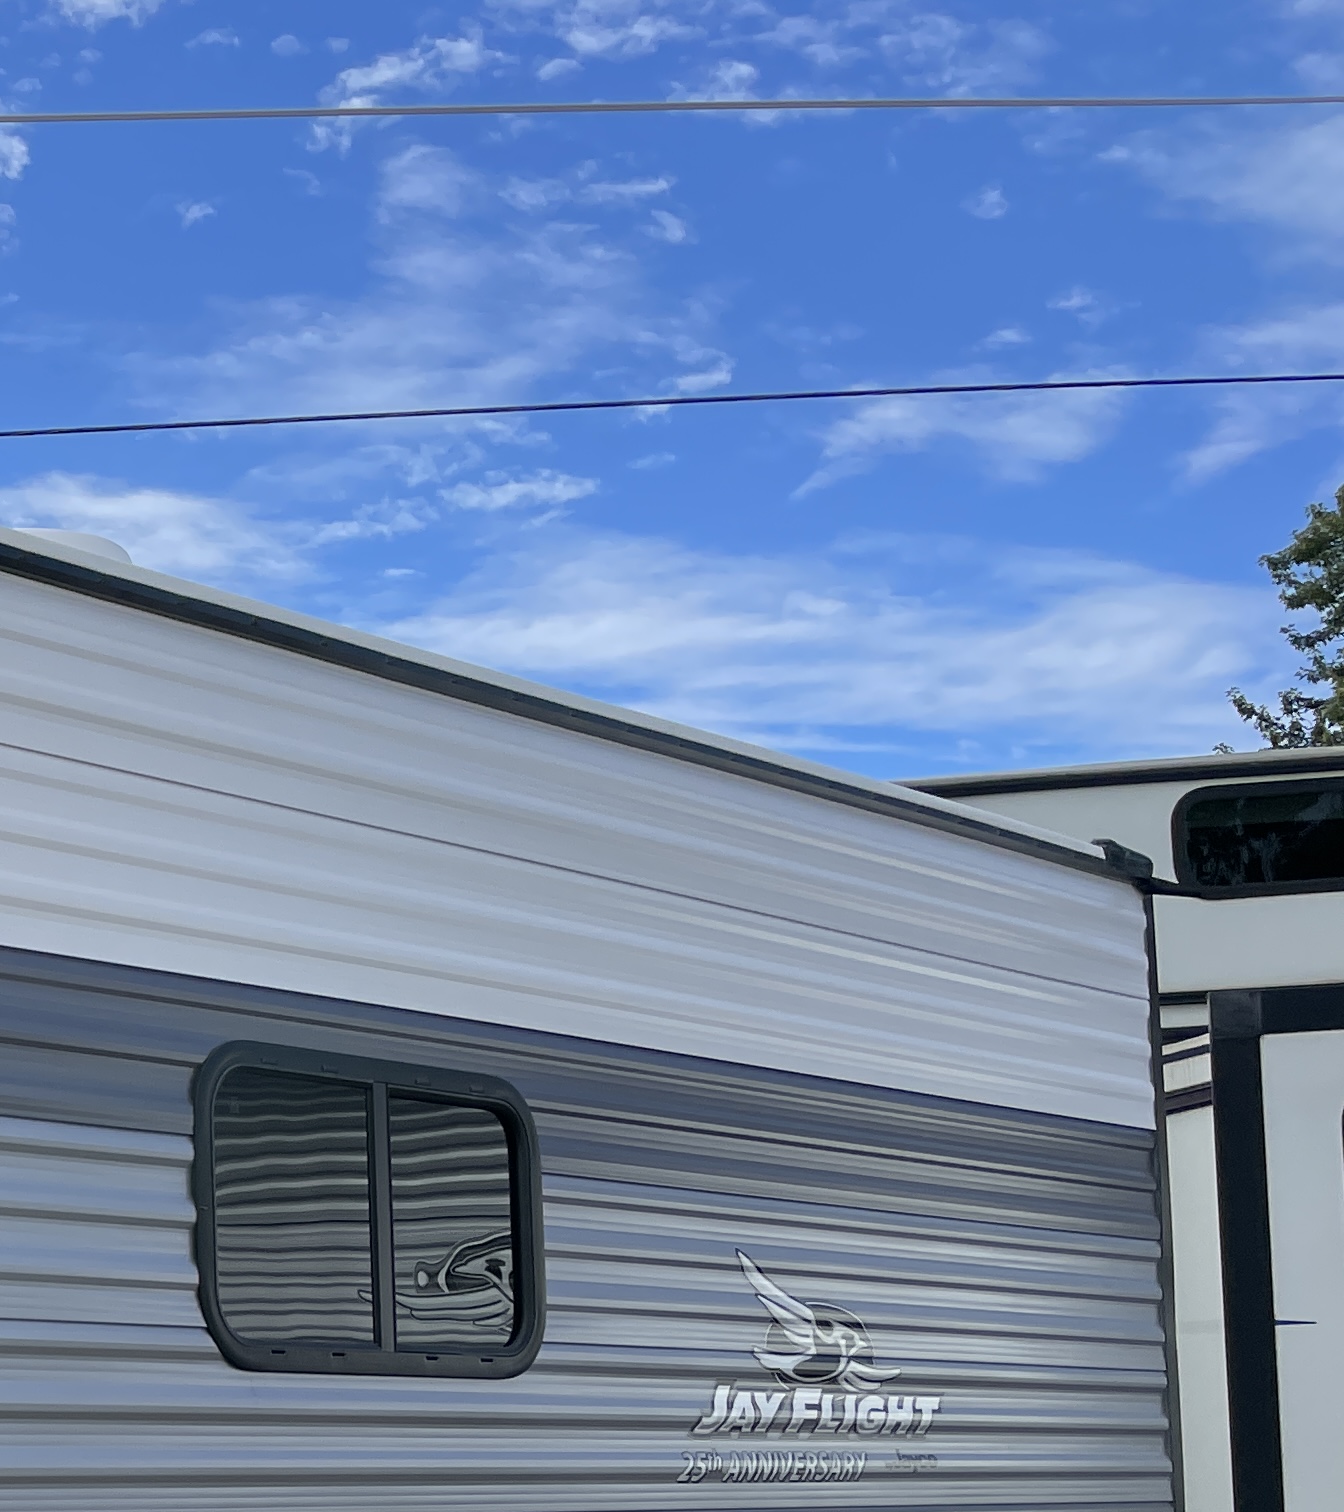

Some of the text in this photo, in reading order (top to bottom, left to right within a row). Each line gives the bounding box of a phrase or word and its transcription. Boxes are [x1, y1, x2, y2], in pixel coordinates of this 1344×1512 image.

[786, 1388, 941, 1435] FLIGHT
[676, 1449, 723, 1483] 25th
[722, 1450, 867, 1482] ANNIVERSARY
